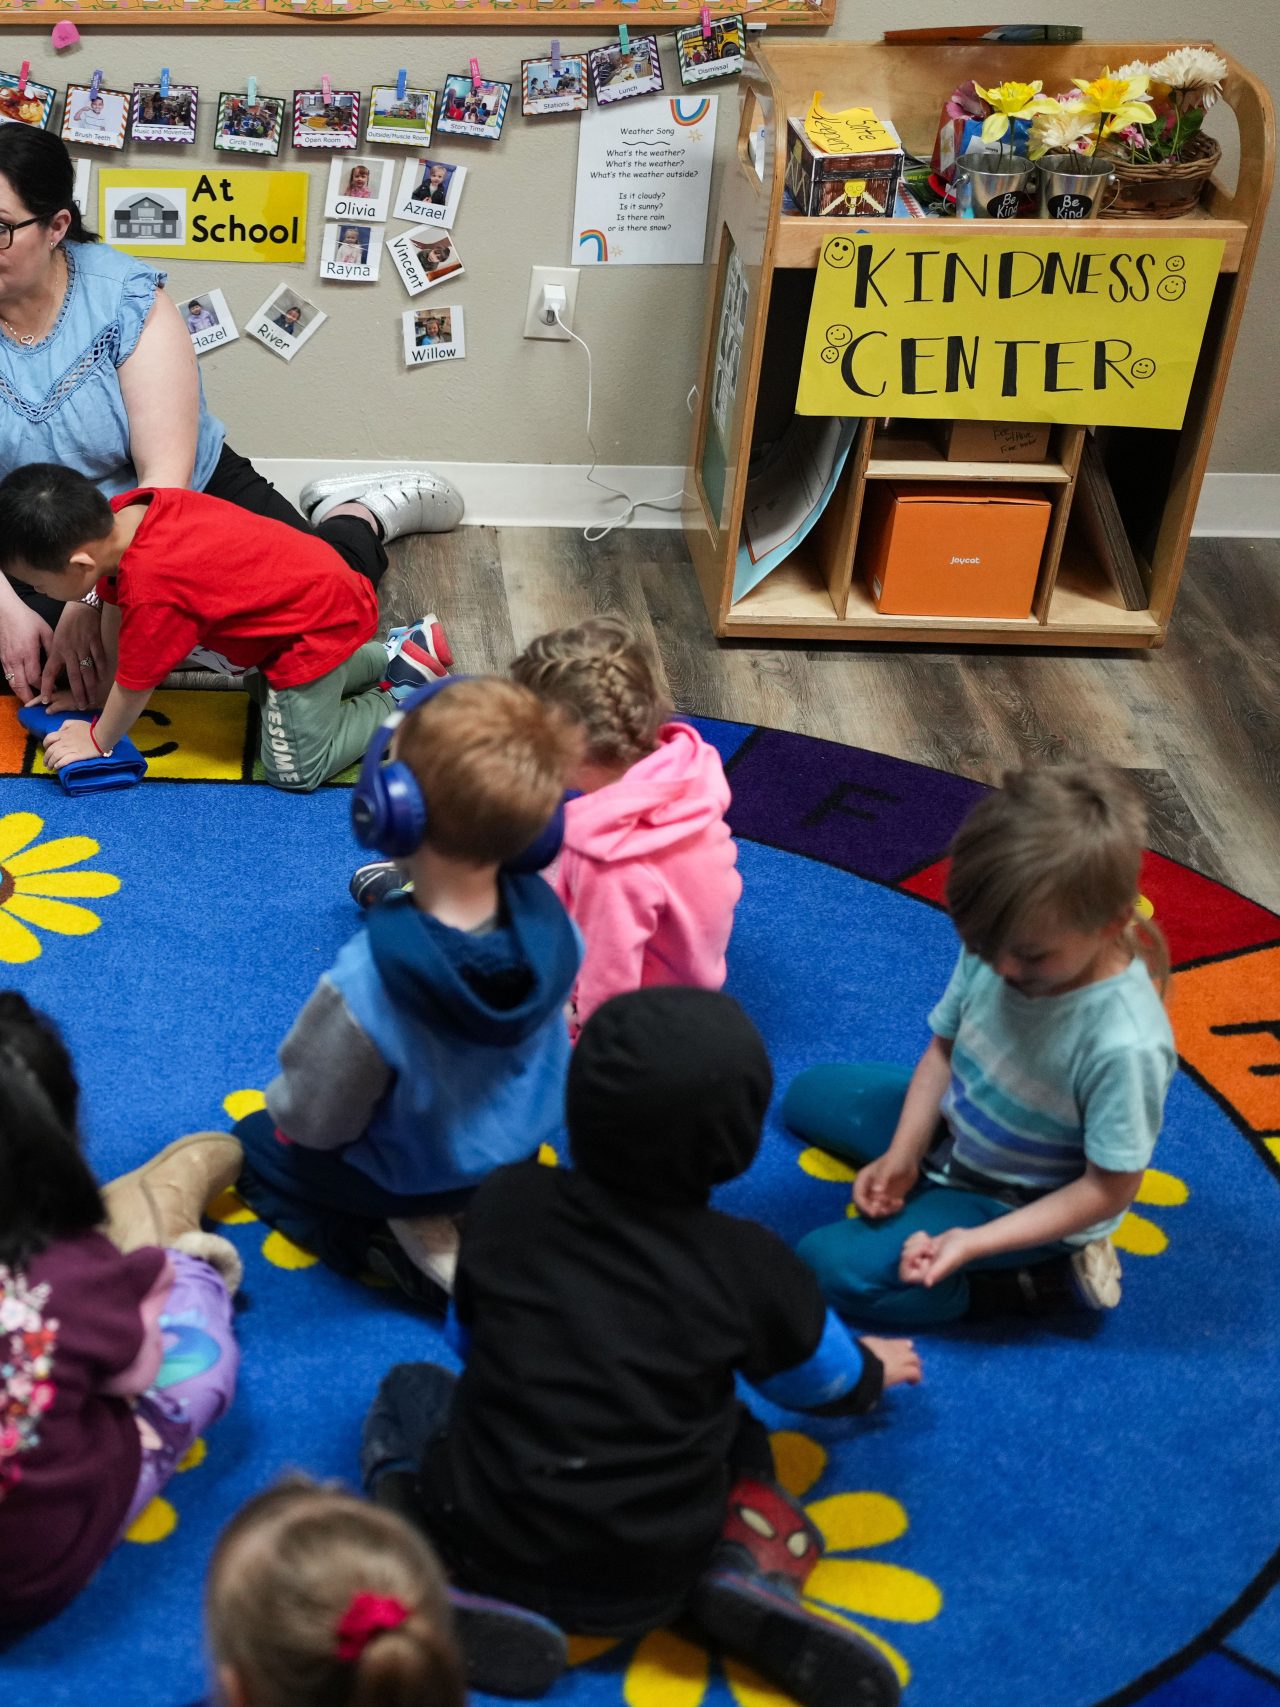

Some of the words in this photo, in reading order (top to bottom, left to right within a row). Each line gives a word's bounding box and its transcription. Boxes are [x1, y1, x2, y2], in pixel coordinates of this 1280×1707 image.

[698, 63, 729, 75] Dismissal
[618, 84, 638, 94] Lunch
[543, 100, 570, 110] Stations
[450, 123, 467, 134] Story
[656, 128, 675, 136] Song
[74, 131, 93, 140] Brush
[304, 136, 322, 144] Open
[323, 136, 341, 144] Room
[368, 131, 410, 141] Outside/Muscle
[228, 138, 247, 146] Circle
[248, 140, 264, 148] Time
[606, 160, 632, 168] What's
[634, 160, 647, 168] the
[649, 160, 684, 168] weather?
[666, 170, 699, 178] outside?
[192, 174, 234, 202] At
[618, 192, 628, 200] Is
[630, 192, 636, 200] it
[638, 192, 666, 201] cloudy?
[1002, 193, 1016, 206] Be
[1062, 195, 1080, 208] Be
[335, 201, 376, 217] Olivia
[403, 202, 447, 220] Azrael
[638, 203, 664, 212] sunny?
[997, 202, 1019, 218] Kind
[1056, 207, 1084, 219] Kind
[192, 214, 299, 244] School
[649, 224, 672, 232] snow?
[327, 262, 371, 277] Rayna
[394, 238, 425, 289] Vincent
[853, 244, 1156, 309] KINDNESS
[192, 327, 227, 349] Hazel
[257, 324, 290, 351] River
[411, 347, 457, 362] Willow
[840, 330, 1135, 398] CENTER
[268, 688, 300, 783] WESOME
[800, 781, 901, 828] F
